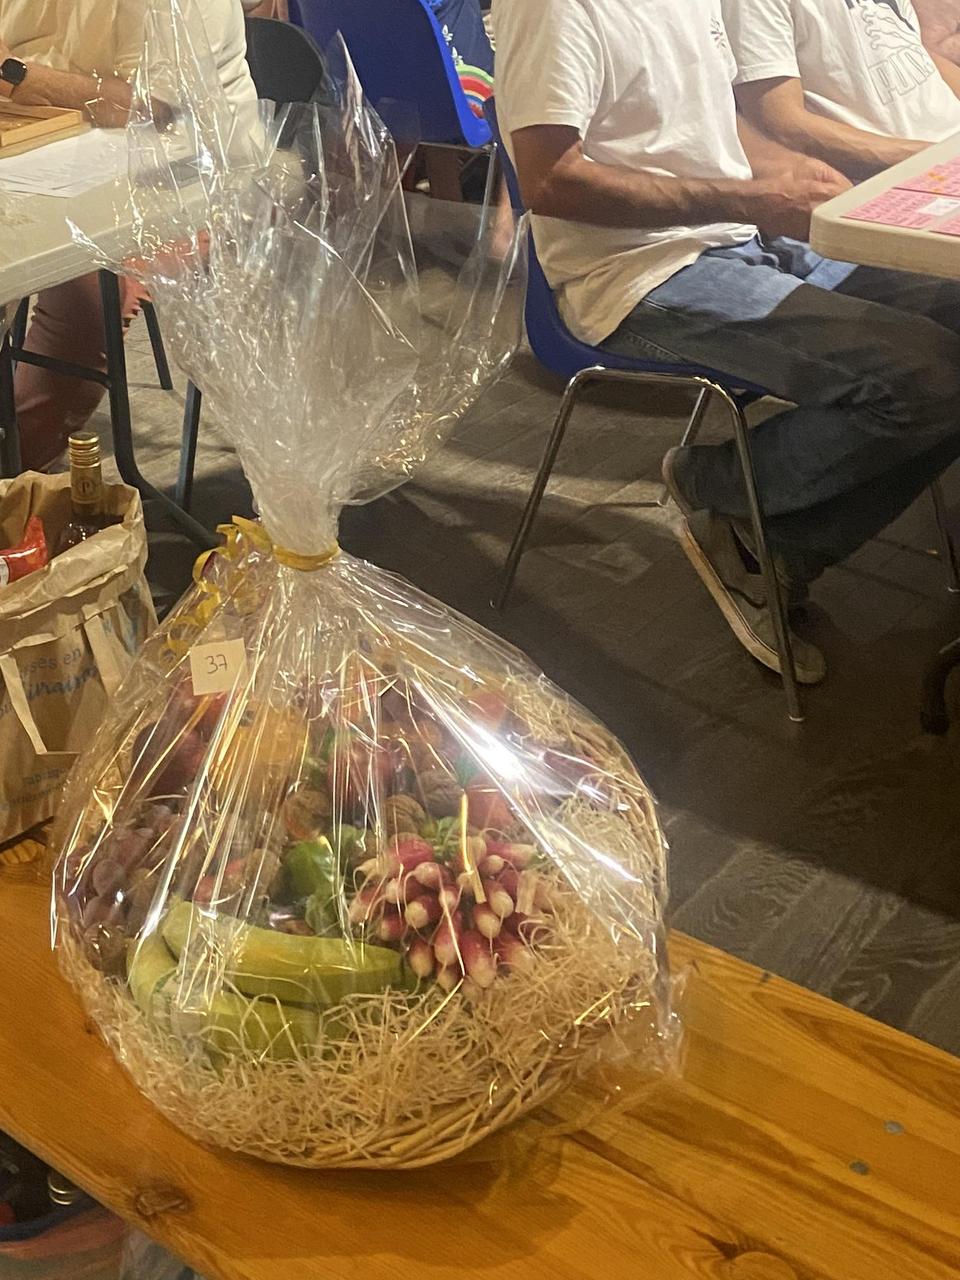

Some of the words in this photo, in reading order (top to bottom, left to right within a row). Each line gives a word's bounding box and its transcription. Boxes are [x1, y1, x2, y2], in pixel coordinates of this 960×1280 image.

[868, 48, 936, 106] PUM
[62, 647, 82, 665] en
[205, 653, 228, 674] 37
